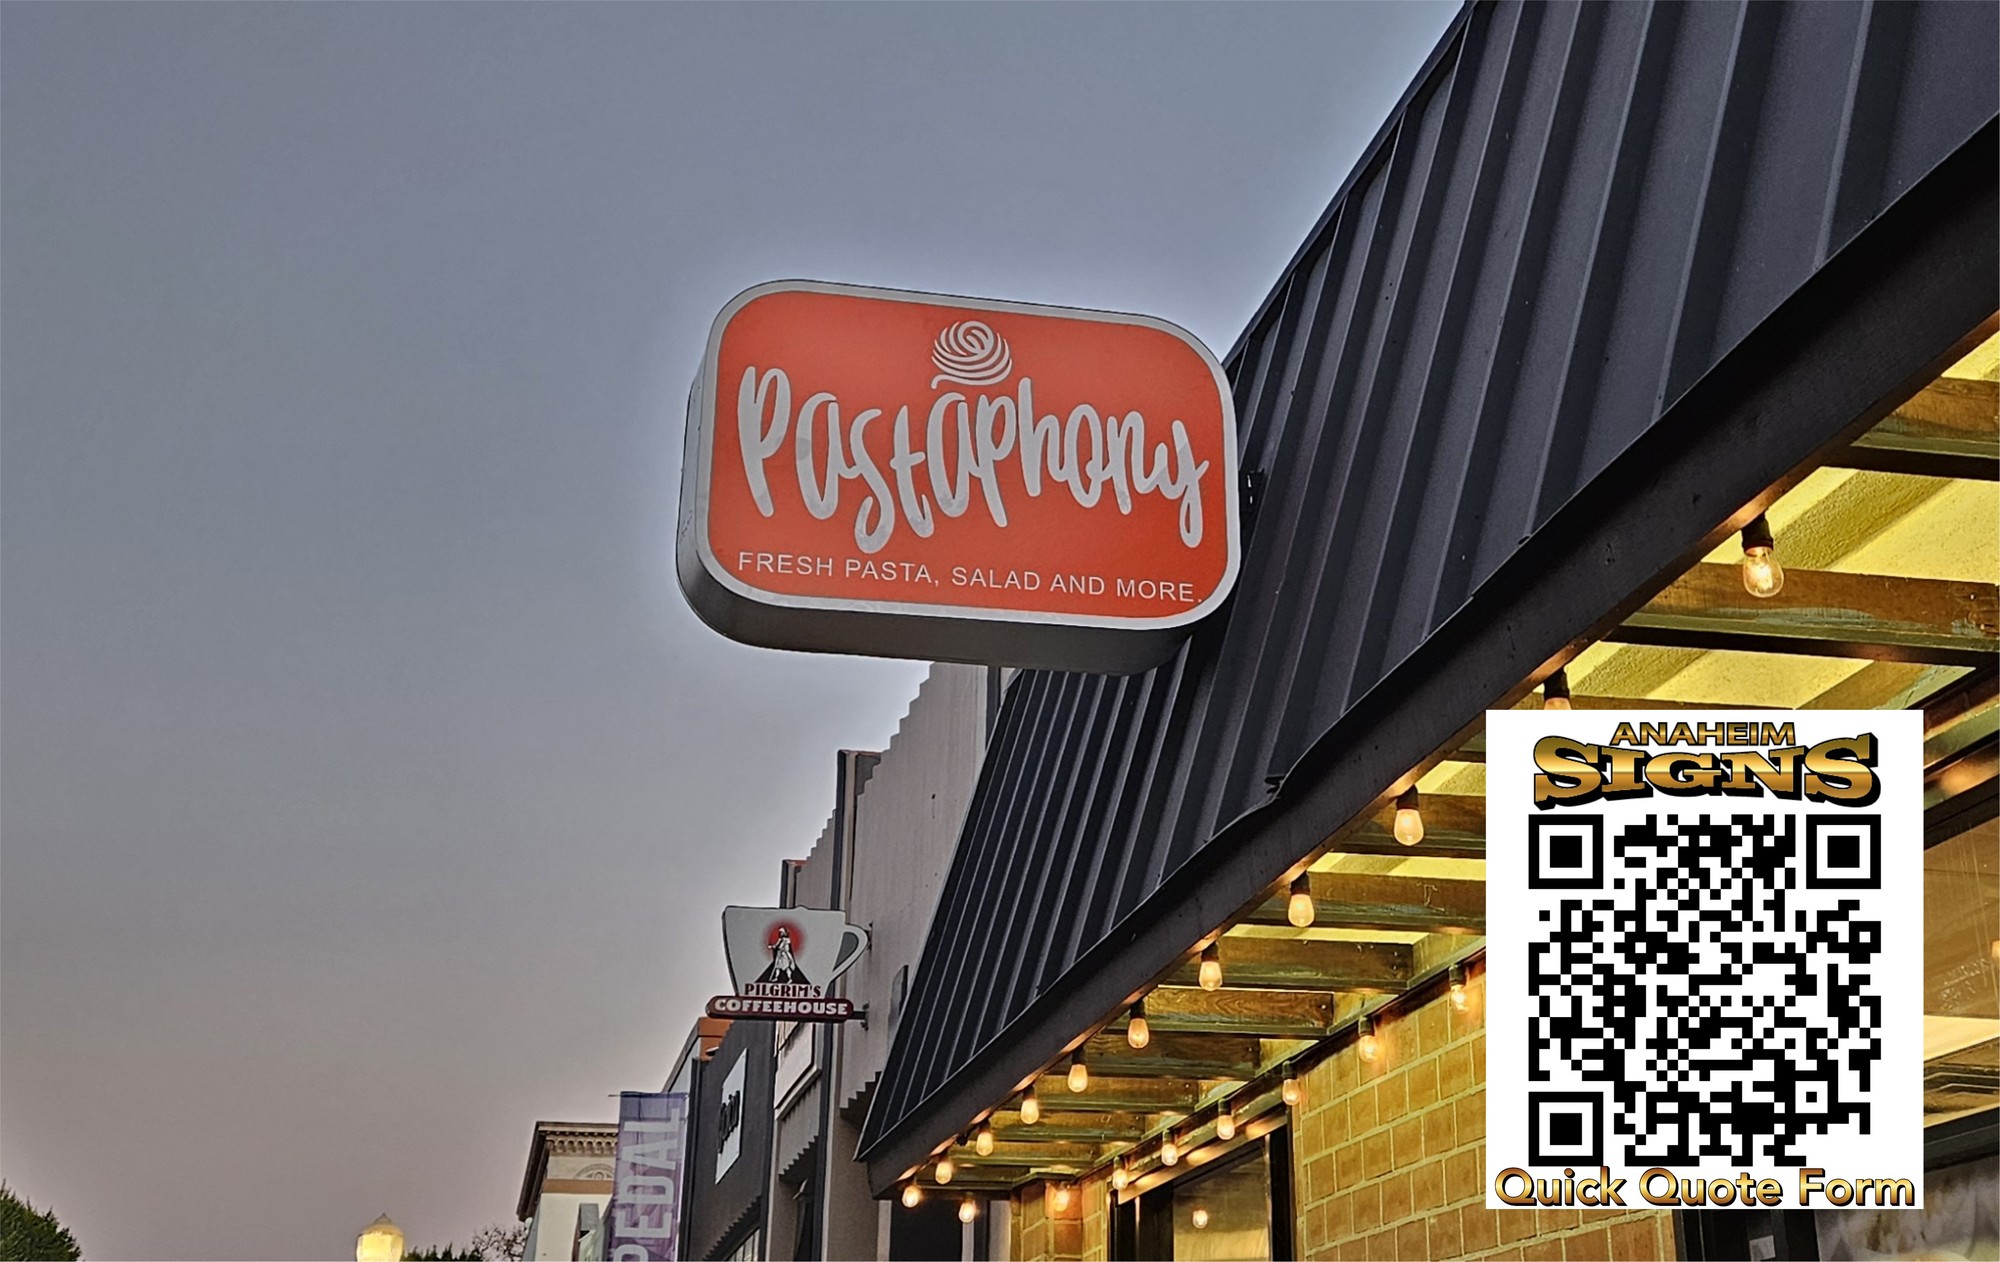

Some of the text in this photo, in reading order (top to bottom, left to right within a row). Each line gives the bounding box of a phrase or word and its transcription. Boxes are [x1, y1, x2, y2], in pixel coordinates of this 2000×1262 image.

[737, 366, 1209, 554] Pastaphony
[738, 551, 1203, 603] FRESH PASTA, SALAD AND MORE.
[714, 999, 848, 1016] COFFEEHOUSE
[744, 983, 821, 998] PILGRIM'S
